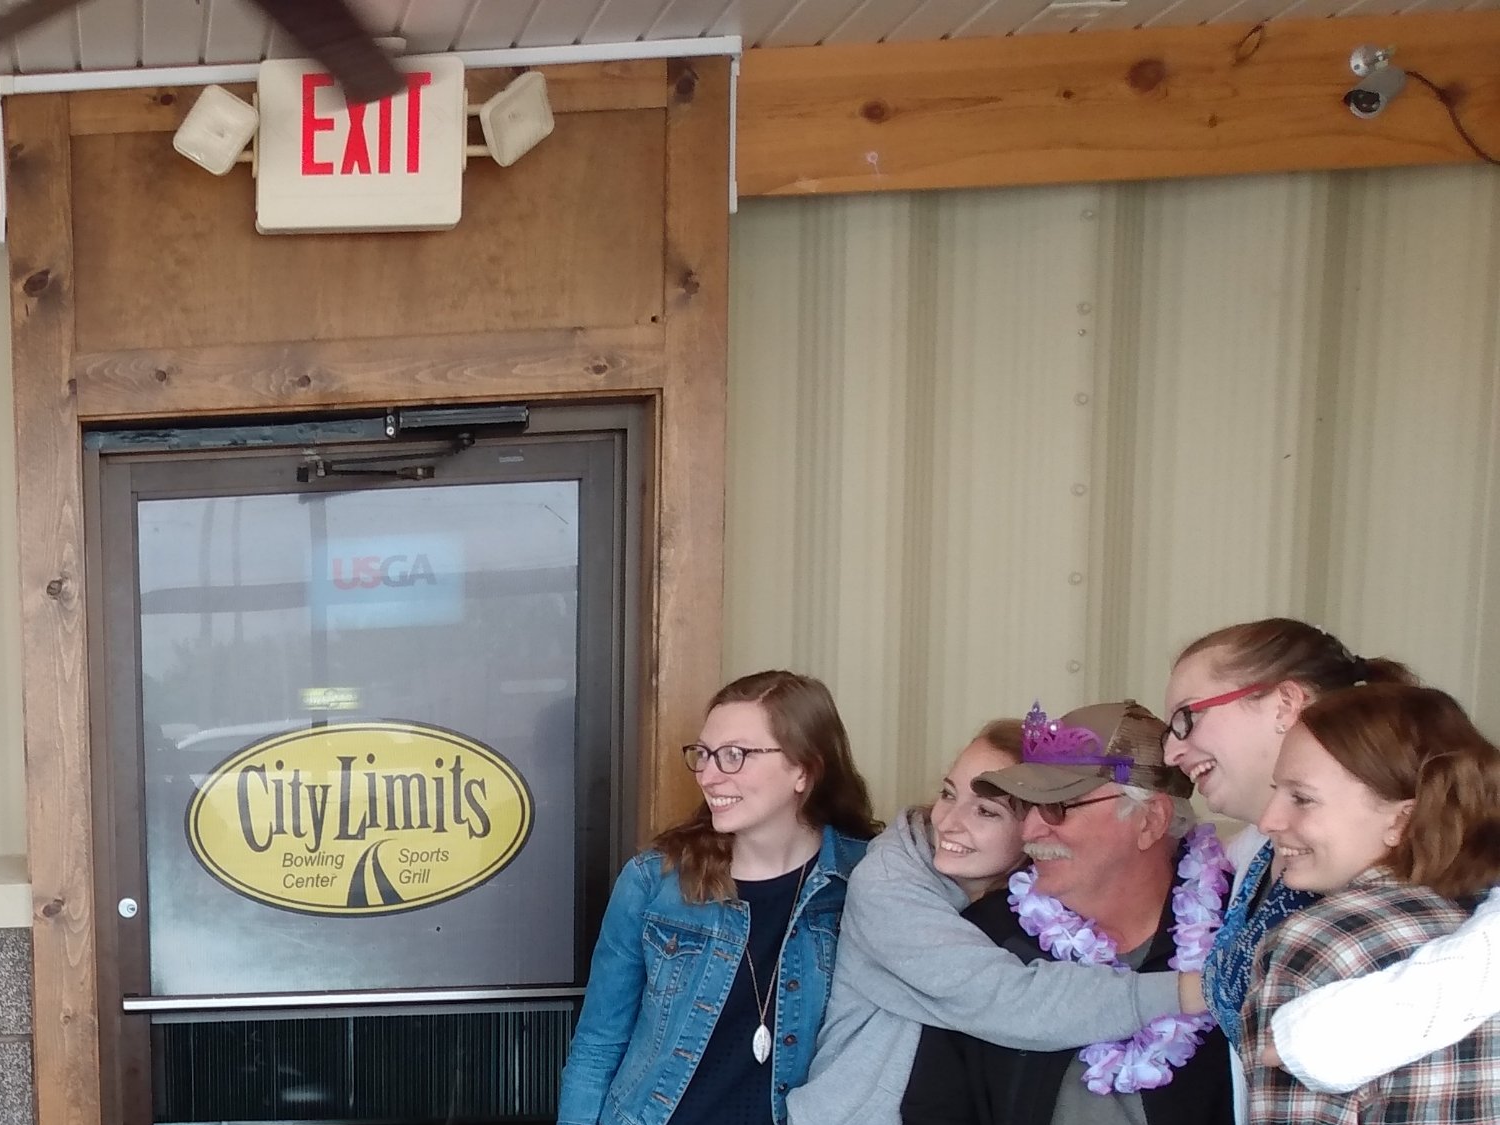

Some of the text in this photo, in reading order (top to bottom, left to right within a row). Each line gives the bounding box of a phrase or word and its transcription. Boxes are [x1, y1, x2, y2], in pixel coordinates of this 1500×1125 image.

[301, 71, 432, 175] EXIT
[332, 553, 438, 590] USGA
[236, 753, 491, 853] City Limits
[282, 851, 345, 870] Bowling
[398, 847, 450, 865] Sports
[282, 872, 338, 889] Center
[398, 868, 431, 885] Grill
